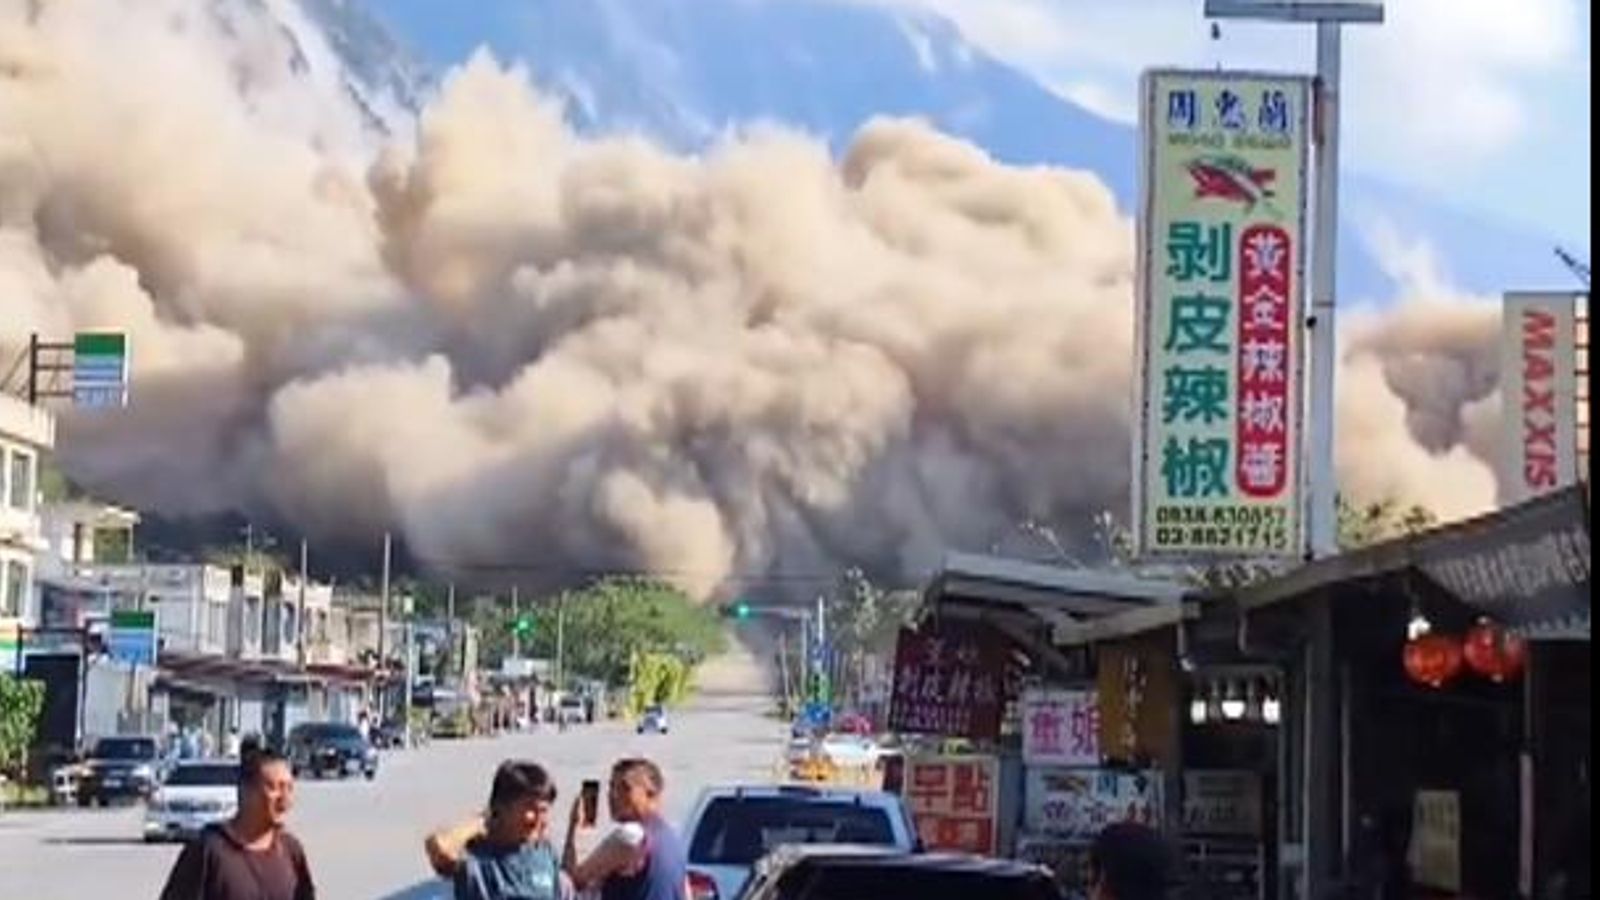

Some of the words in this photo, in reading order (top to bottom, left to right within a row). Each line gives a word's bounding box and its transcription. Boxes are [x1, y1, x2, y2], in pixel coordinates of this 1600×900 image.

[1162, 221, 1231, 497] 剝皮辣椒
[1522, 310, 1558, 489] MAXXIS
